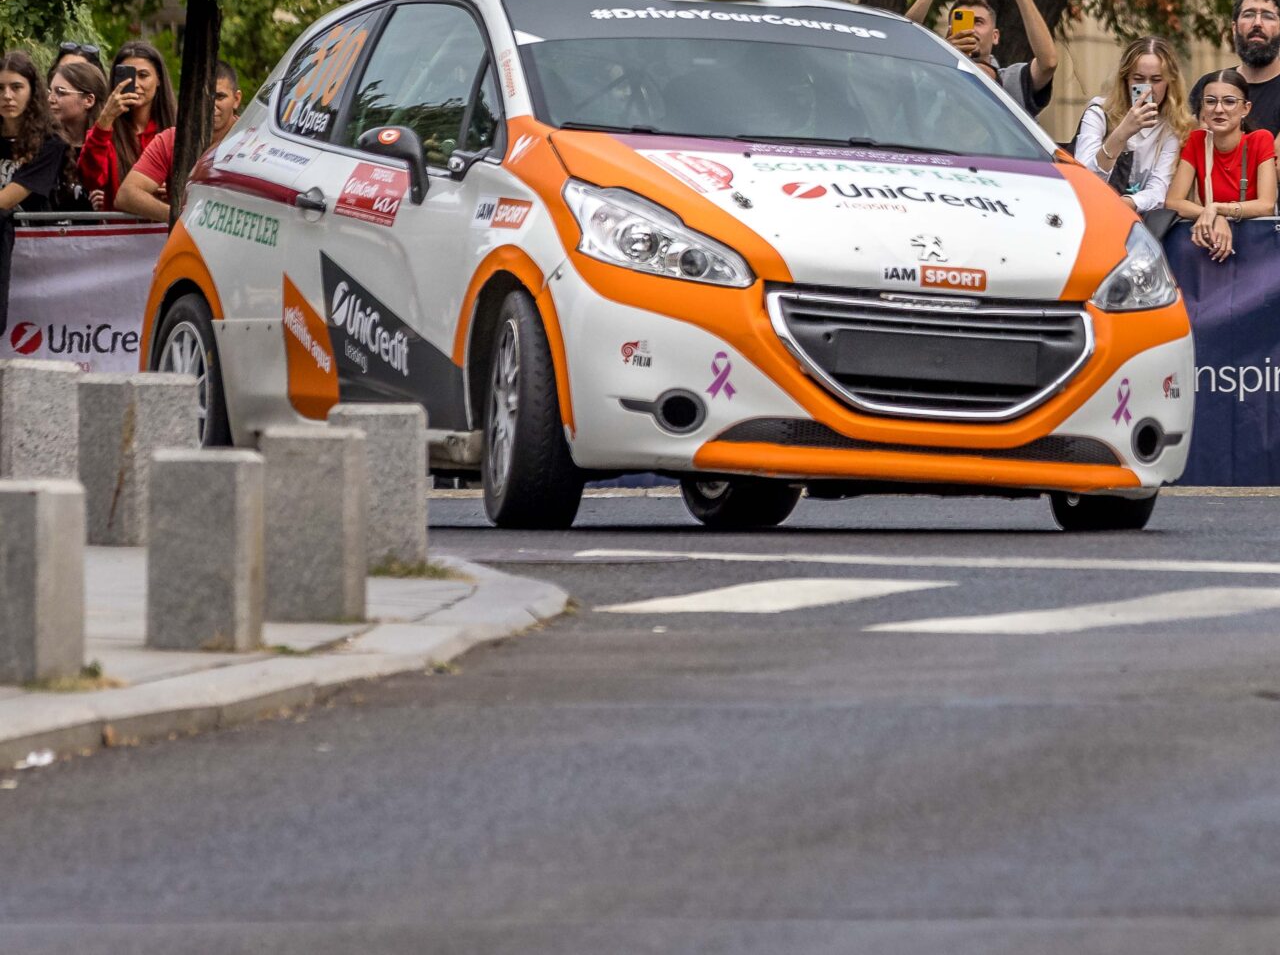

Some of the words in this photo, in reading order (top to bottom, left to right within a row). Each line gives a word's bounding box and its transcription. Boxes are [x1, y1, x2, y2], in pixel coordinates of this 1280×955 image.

[590, 7, 888, 39] #DriveYourCourage
[753, 161, 1003, 189] SCHAEFFLER
[494, 203, 531, 223] SPORT
[831, 182, 1015, 218] UniCredit
[843, 201, 907, 214] Leasing
[199, 199, 281, 247] SCHAEFFLER
[884, 267, 916, 282] iAM
[924, 269, 983, 288] SPORT
[346, 293, 410, 377] UniCredit
[343, 338, 369, 374] Leasing
